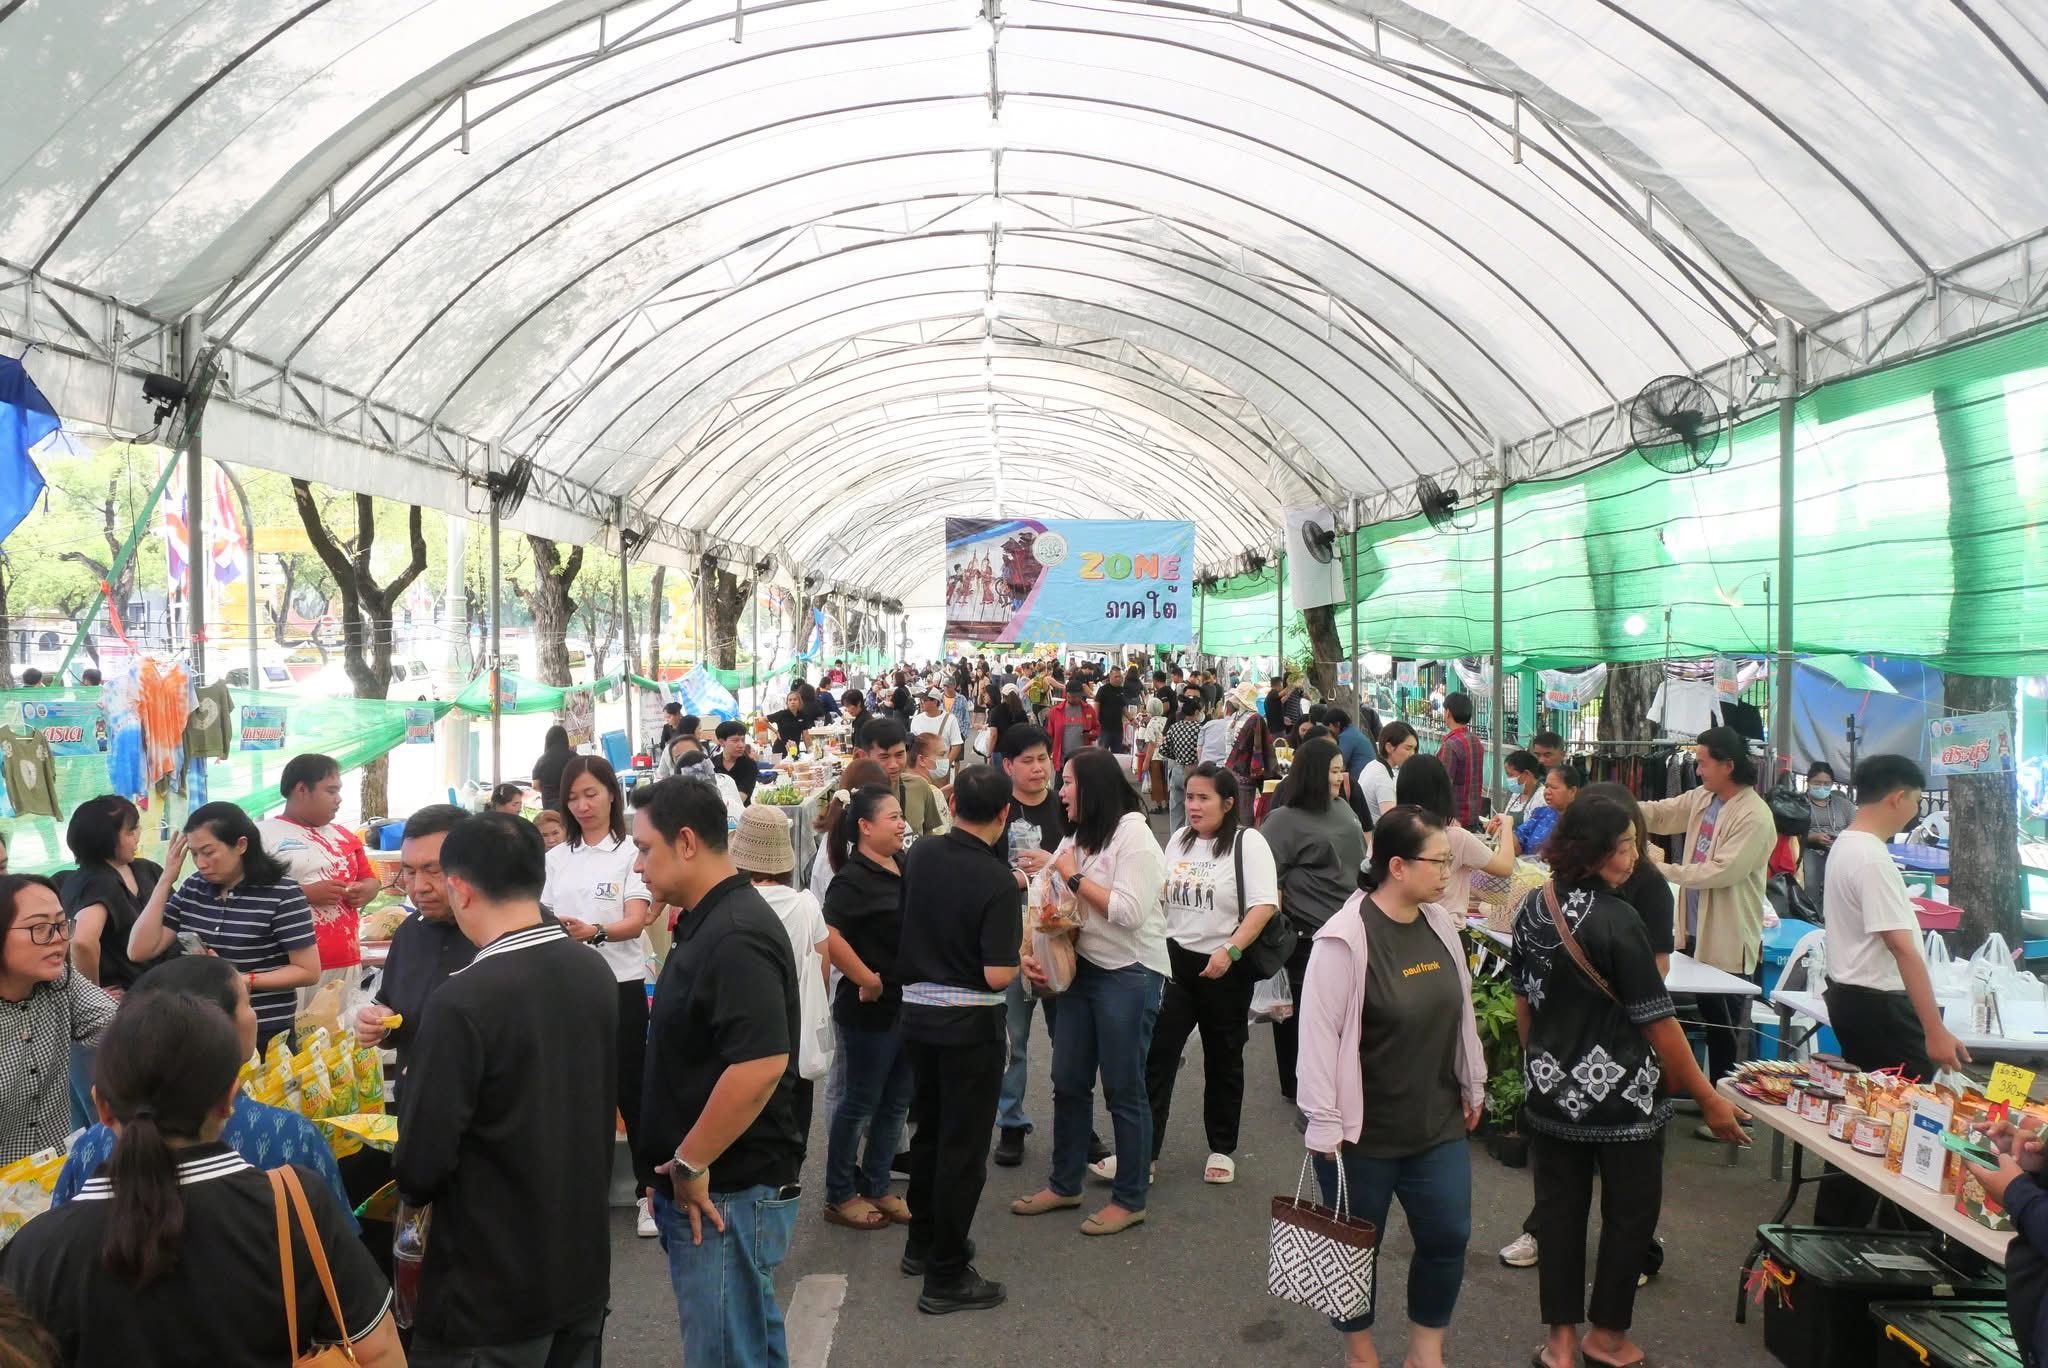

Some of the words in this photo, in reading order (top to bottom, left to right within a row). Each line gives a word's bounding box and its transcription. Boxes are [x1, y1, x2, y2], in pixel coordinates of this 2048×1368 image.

[1079, 552, 1181, 580] ZONE
[1105, 585, 1178, 620] ภาคใต้
[1942, 736, 1991, 771] สระบุรี
[1402, 963, 1421, 978] paul
[1420, 960, 1441, 972] frank
[1998, 1079, 2018, 1096] 380
